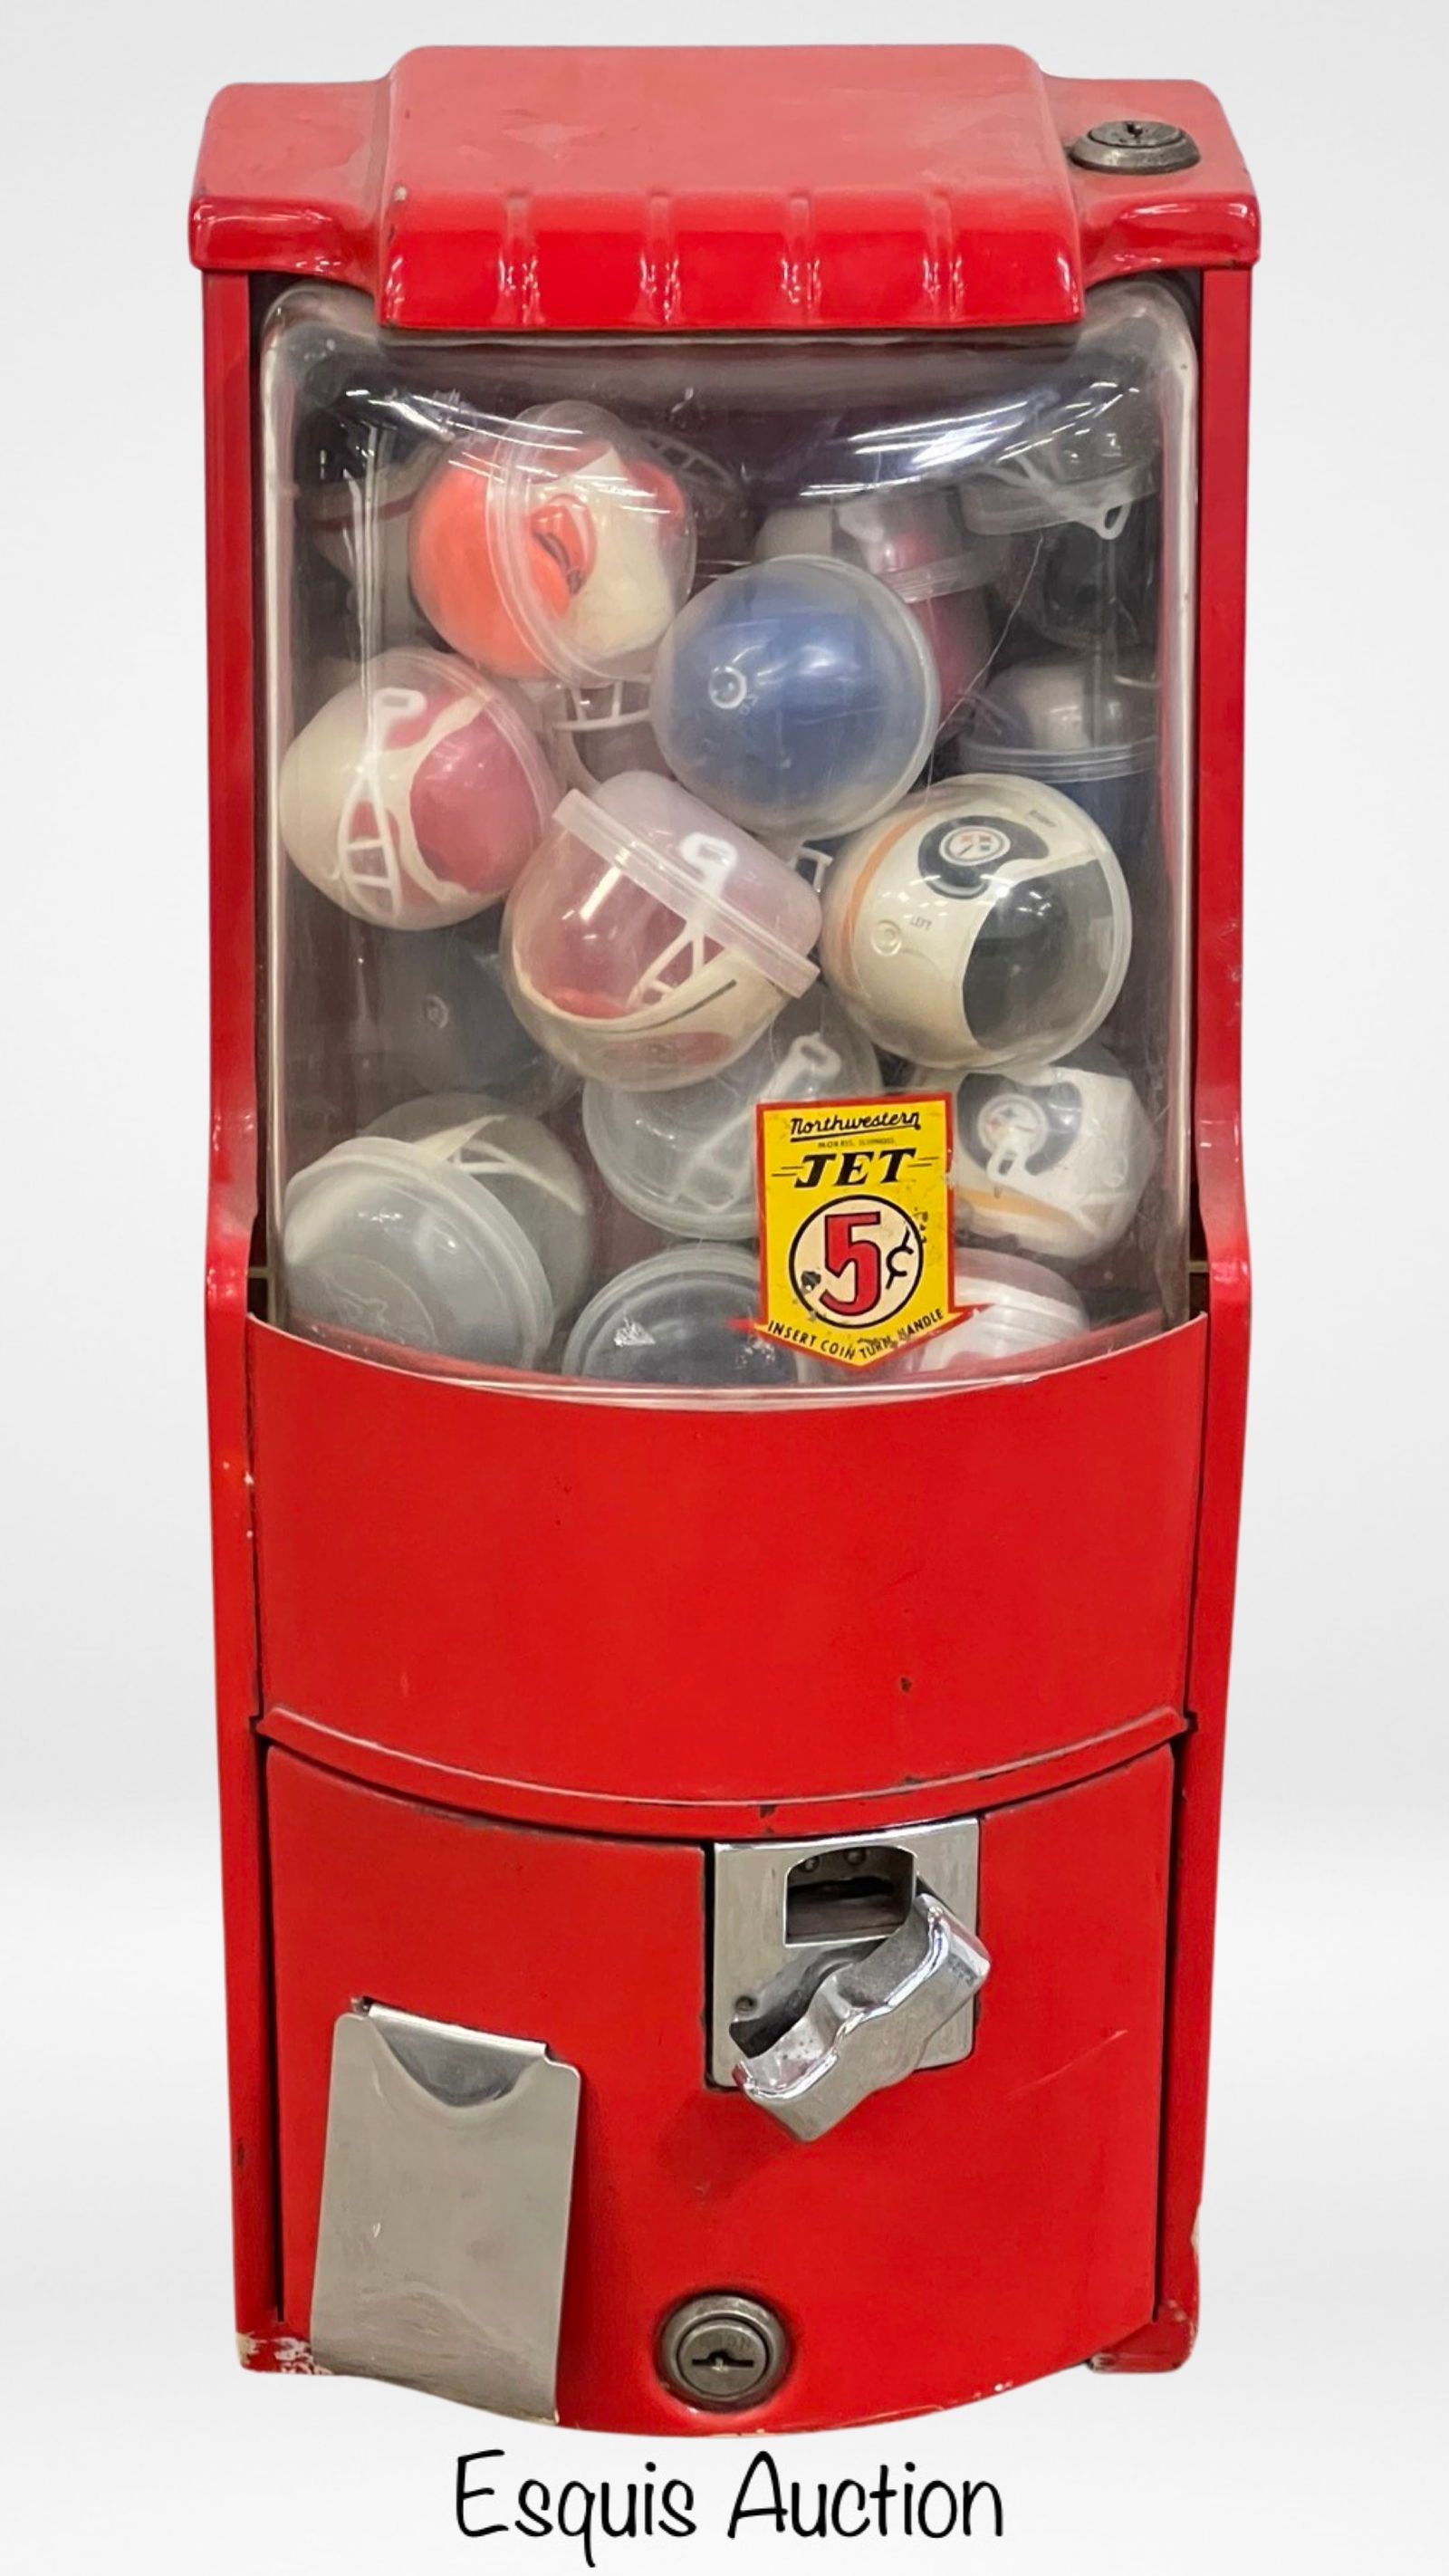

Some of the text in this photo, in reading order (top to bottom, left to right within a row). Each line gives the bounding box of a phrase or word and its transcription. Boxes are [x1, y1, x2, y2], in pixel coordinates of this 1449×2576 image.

[791, 1111, 921, 1136] Northwestern
[794, 1148, 916, 1188] JET
[768, 1320, 817, 1347] INSERT
[820, 1339, 856, 1360] COIN
[859, 1335, 893, 1359] TURN
